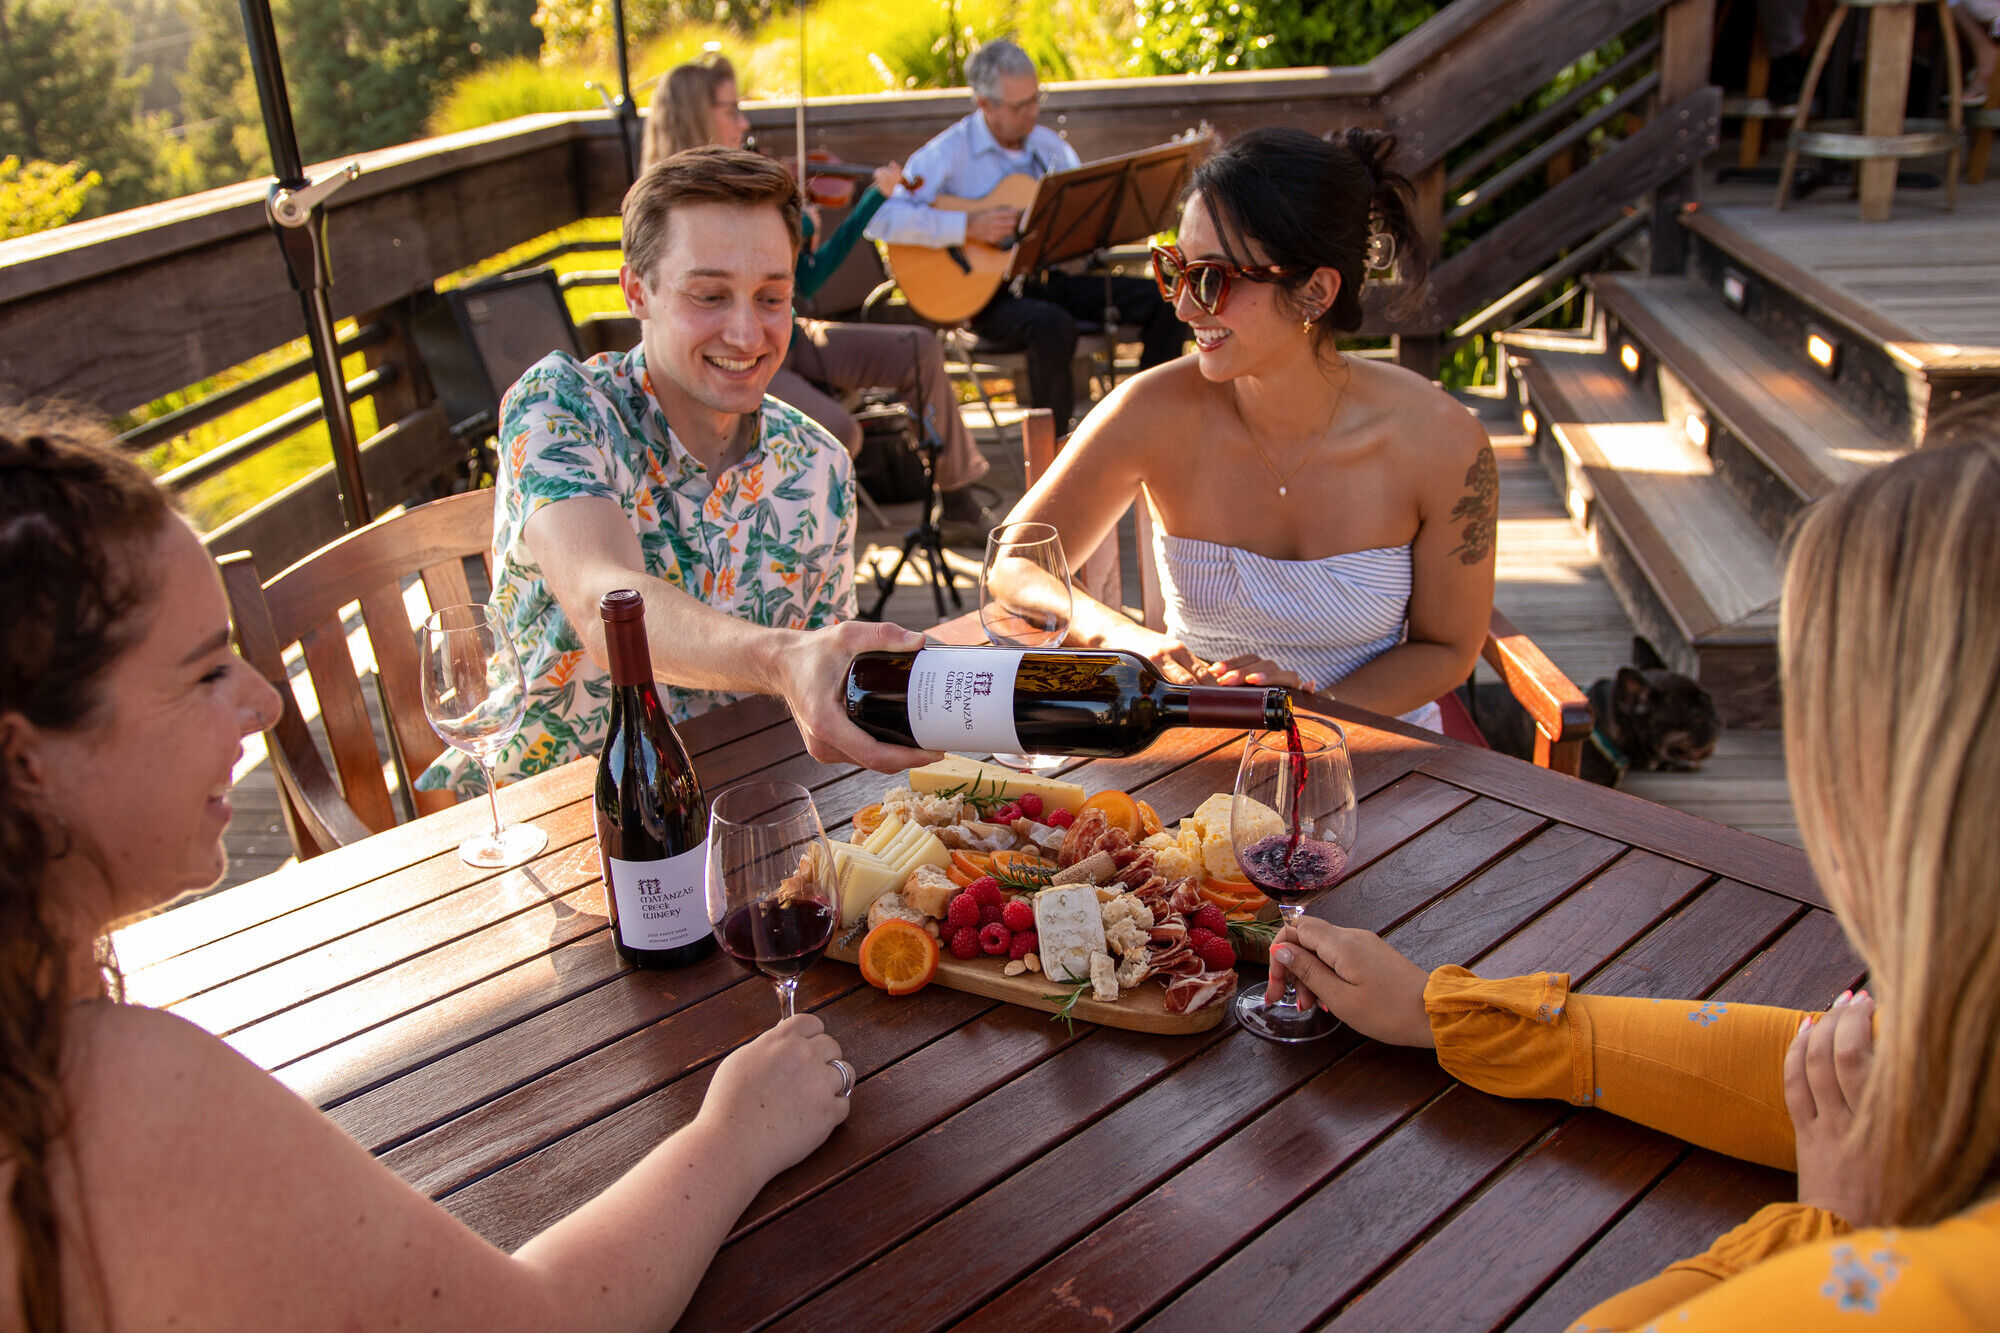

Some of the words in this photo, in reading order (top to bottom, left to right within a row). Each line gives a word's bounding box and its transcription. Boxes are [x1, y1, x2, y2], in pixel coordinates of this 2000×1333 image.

[942, 670, 956, 713] WINERY
[963, 671, 974, 731] MATANZAS
[640, 887, 694, 903] MATANZAS
[642, 908, 682, 920] WINERY
